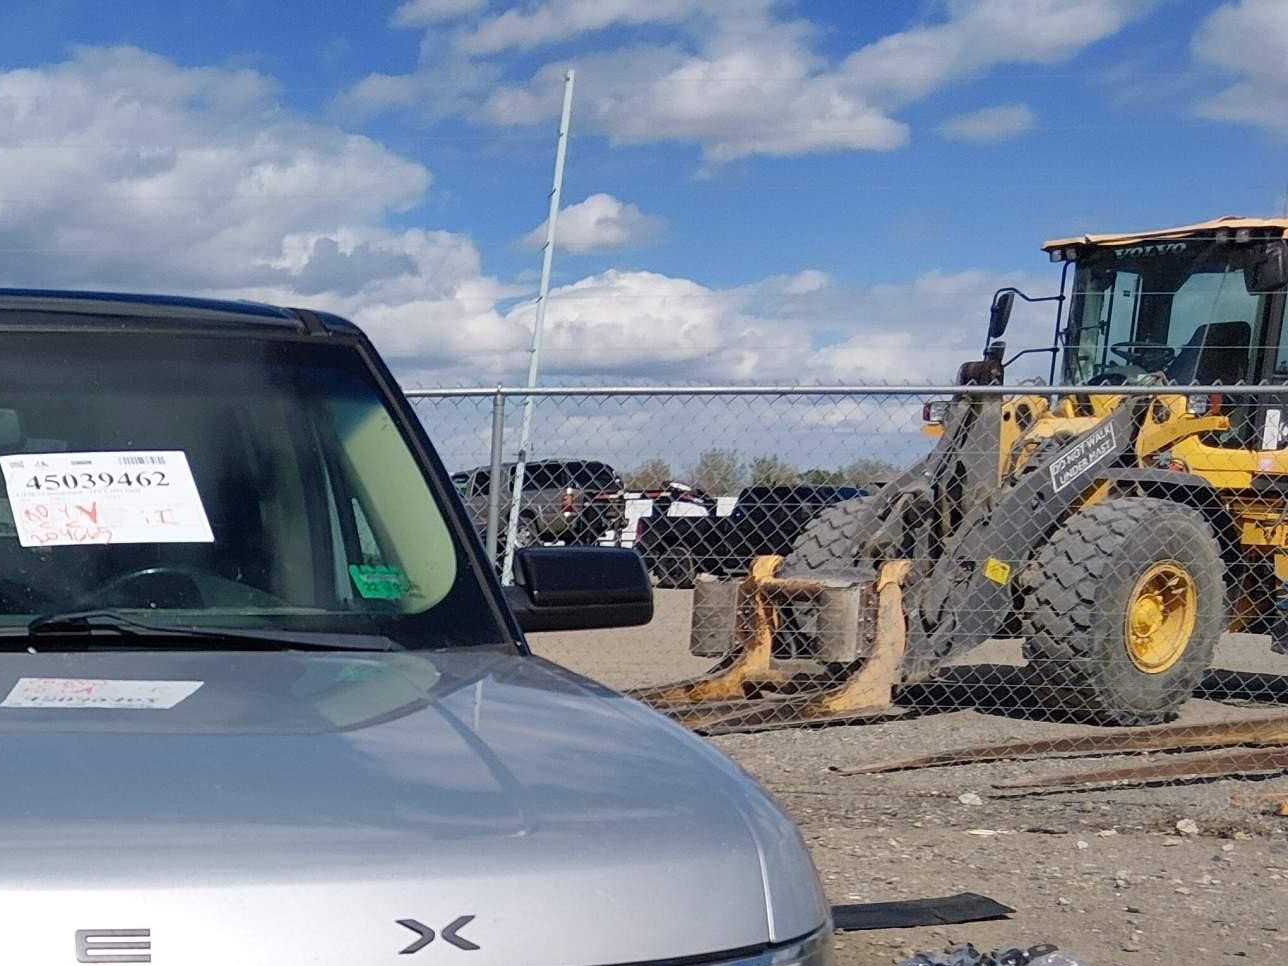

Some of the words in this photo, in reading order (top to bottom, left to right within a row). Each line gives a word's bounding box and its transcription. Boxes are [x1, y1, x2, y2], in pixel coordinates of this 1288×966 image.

[1113, 243, 1187, 258] VOLVO
[1053, 459, 1066, 475] DO
[1067, 442, 1086, 463] NOT
[1086, 424, 1112, 448] WALK
[1059, 458, 1089, 485] UNDER
[1089, 440, 1111, 462] MAST
[25, 471, 170, 491] 45039462
